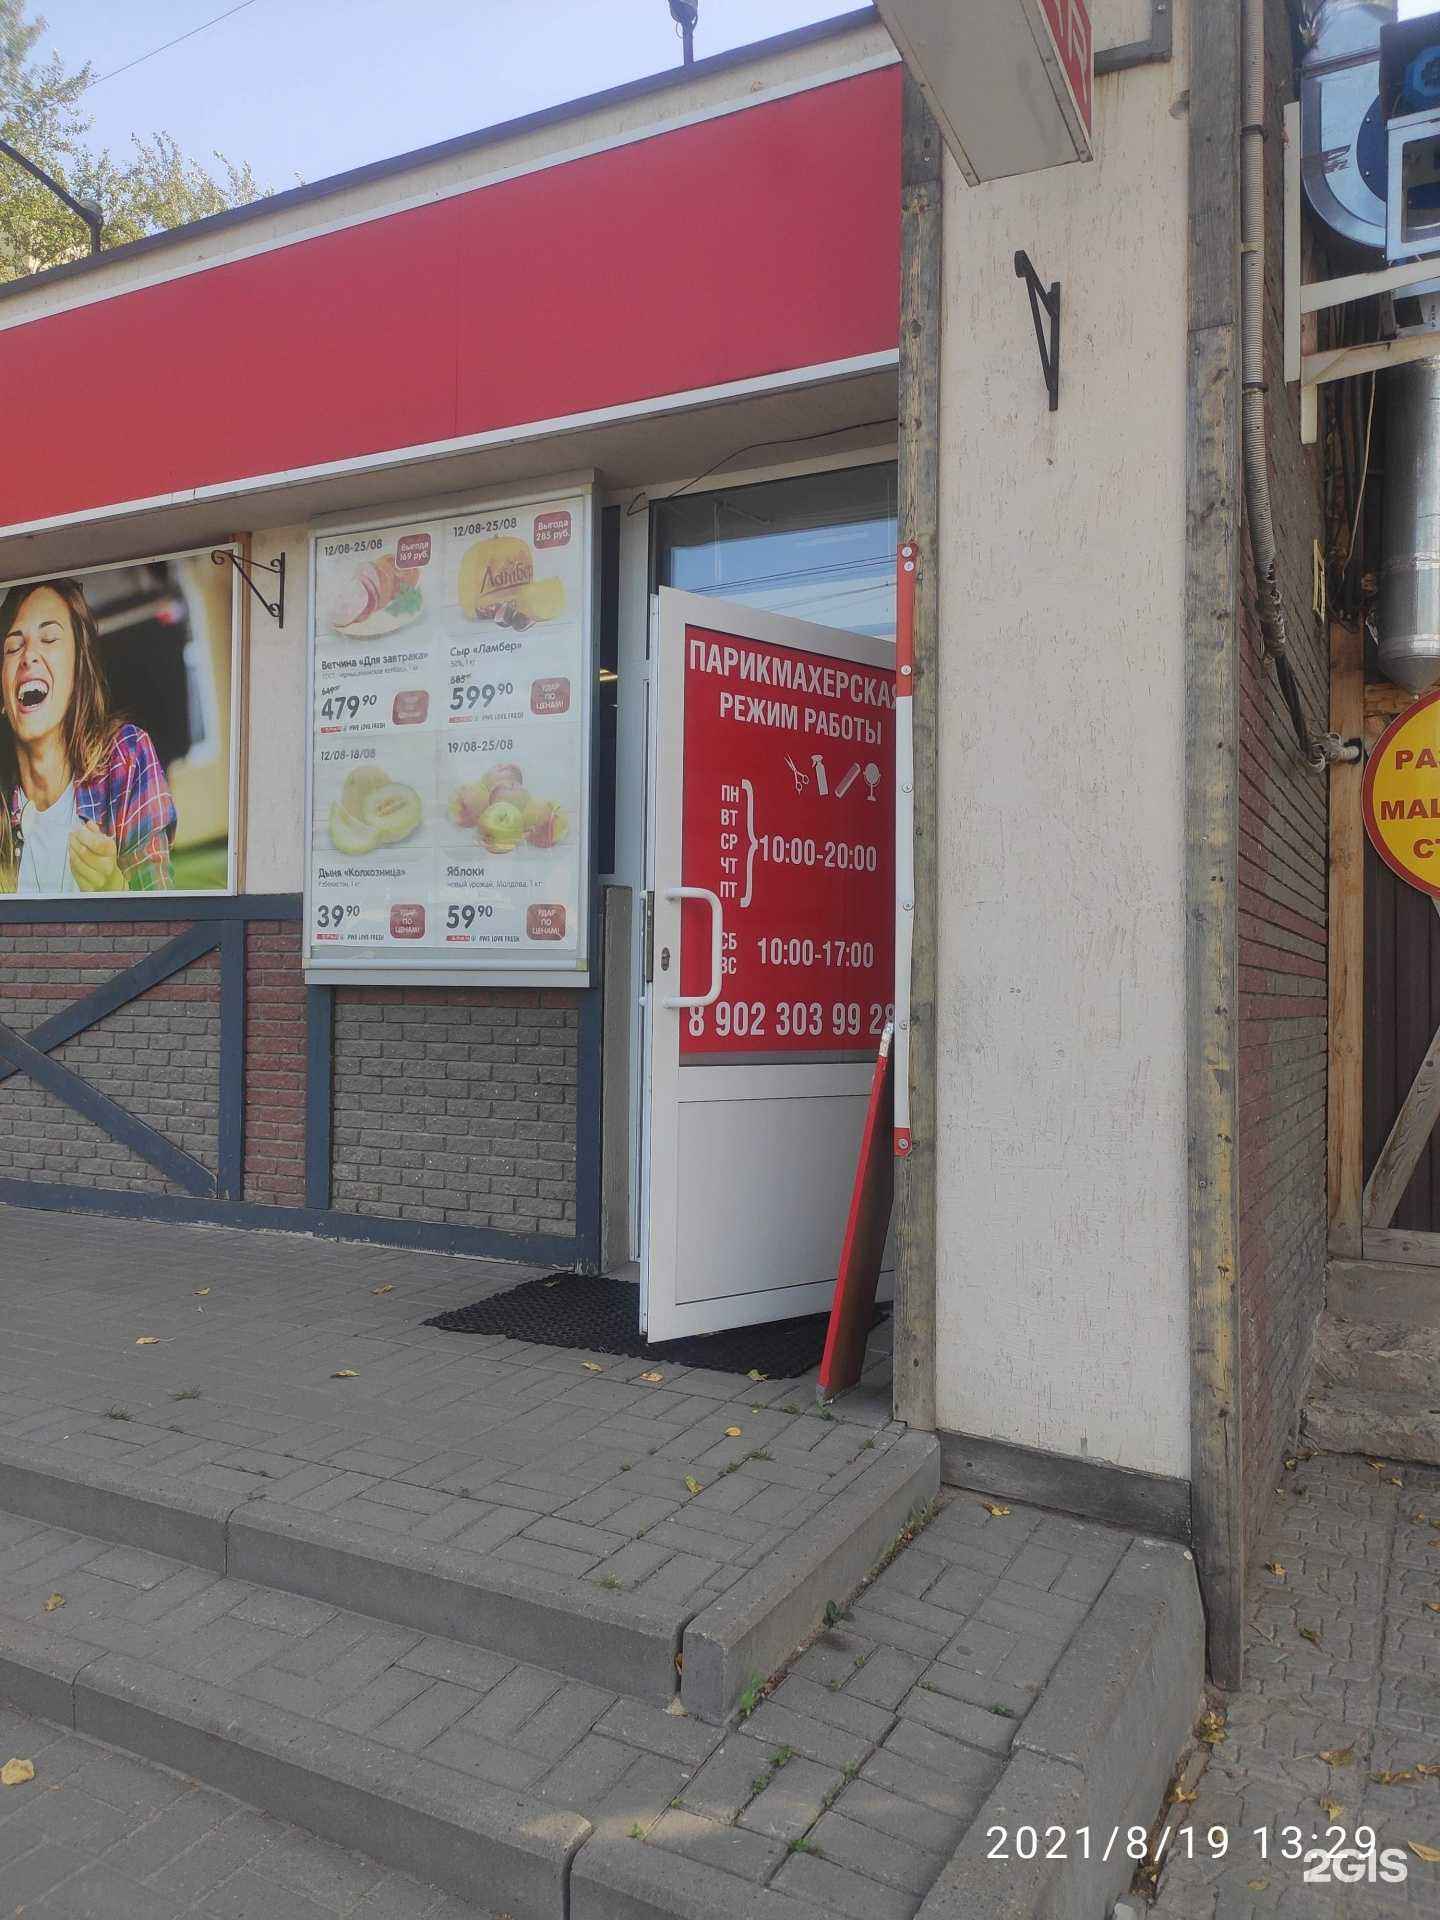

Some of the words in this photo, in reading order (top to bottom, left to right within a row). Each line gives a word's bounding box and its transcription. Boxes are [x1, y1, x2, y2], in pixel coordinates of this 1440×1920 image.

[454, 517, 518, 537] 12/08-25/08
[538, 520, 569, 531] Выгода
[324, 539, 383, 556] 12/08-25/08
[450, 646, 471, 658] Сыр
[473, 640, 522, 654] «Ламбер»
[321, 659, 358, 671] Ветчина
[719, 692, 798, 731] РЕЖИМ
[804, 708, 882, 745] РАБОТЫ
[320, 748, 376, 761] 12/08-18/08
[447, 739, 514, 753] 19/08-25/08
[1395, 748, 1440, 770] РА
[721, 784, 739, 802] ПН
[720, 809, 738, 826] ВТ
[720, 833, 738, 850] СР
[758, 834, 878, 872] 10:00-20:00
[319, 868, 342, 879] Дыня
[344, 867, 406, 879] «Колхозница»
[447, 866, 485, 877] Яблоки
[720, 857, 738, 875] ЧТ
[719, 881, 738, 899] ПТ
[757, 936, 875, 968] 10:00-17:00
[688, 1005, 705, 1037] 8
[715, 1001, 766, 1037] 902
[776, 1002, 823, 1036] 303
[831, 1002, 861, 1036] 99
